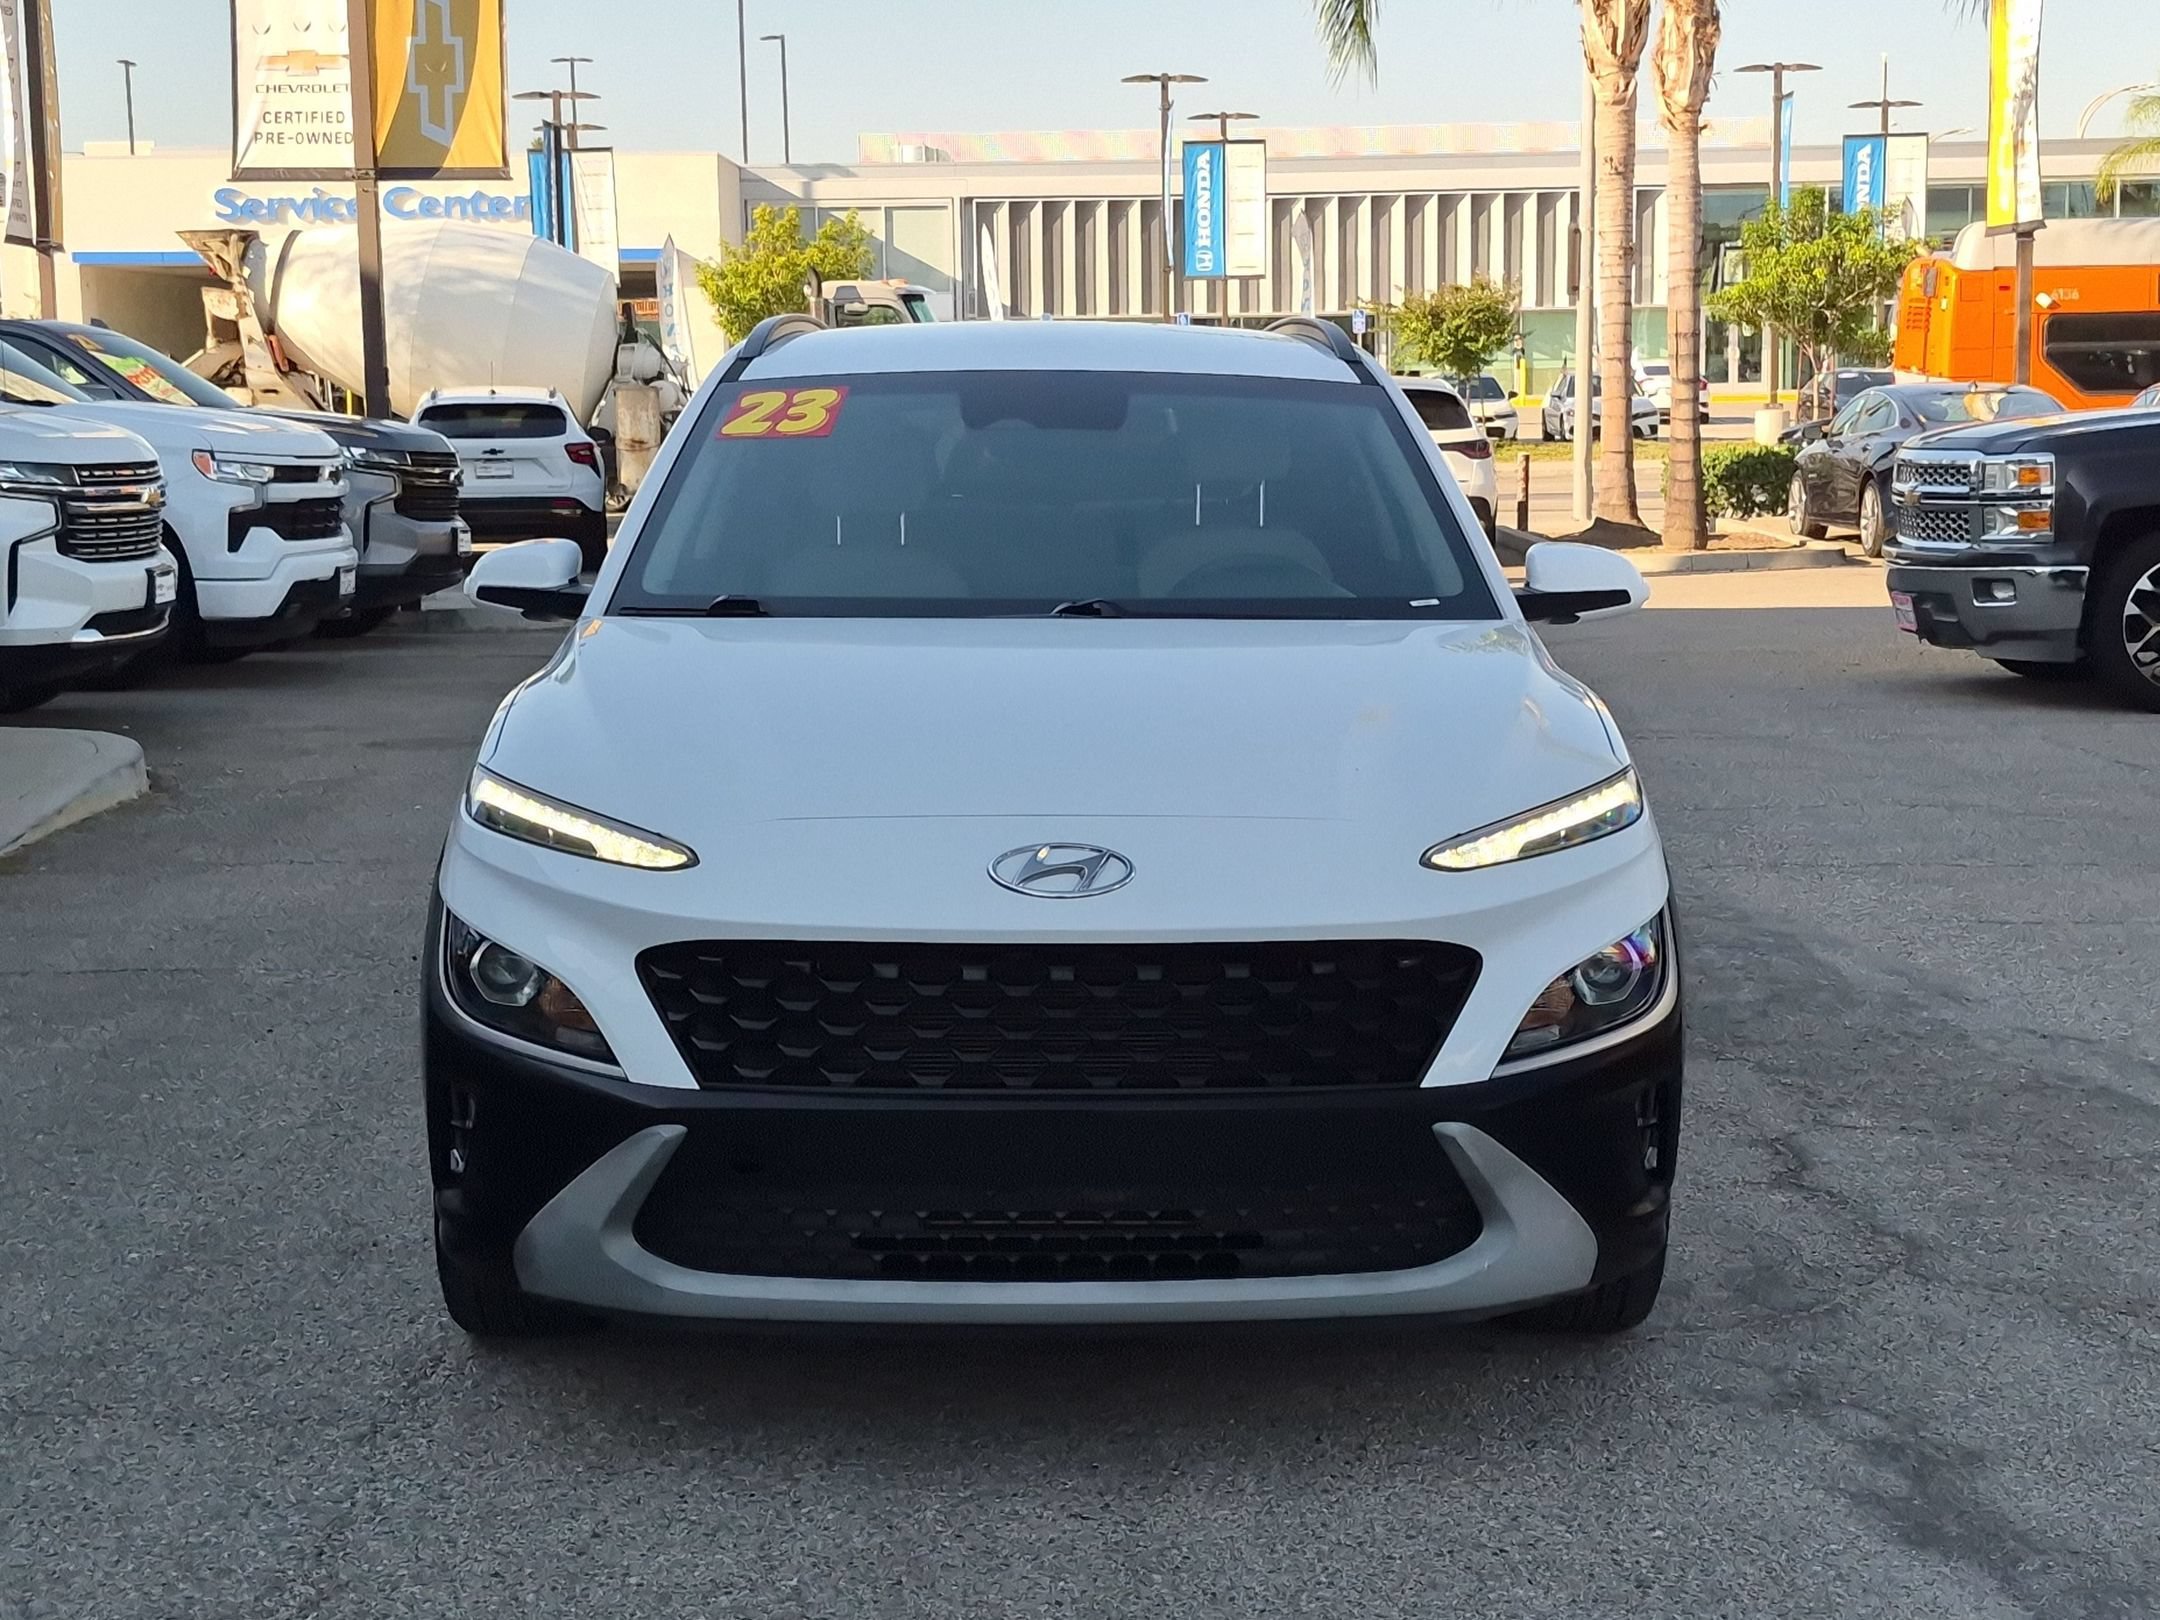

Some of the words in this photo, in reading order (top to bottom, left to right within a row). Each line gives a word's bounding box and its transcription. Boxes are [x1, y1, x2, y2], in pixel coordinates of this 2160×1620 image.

[255, 83, 349, 94] CHEVROLET
[262, 110, 346, 125] CERTIFIED
[254, 131, 354, 146] PRE-OWNED
[1856, 143, 1872, 212] NDA
[383, 186, 531, 221] Center
[1195, 149, 1212, 248] HONDA
[720, 388, 841, 437] 23
